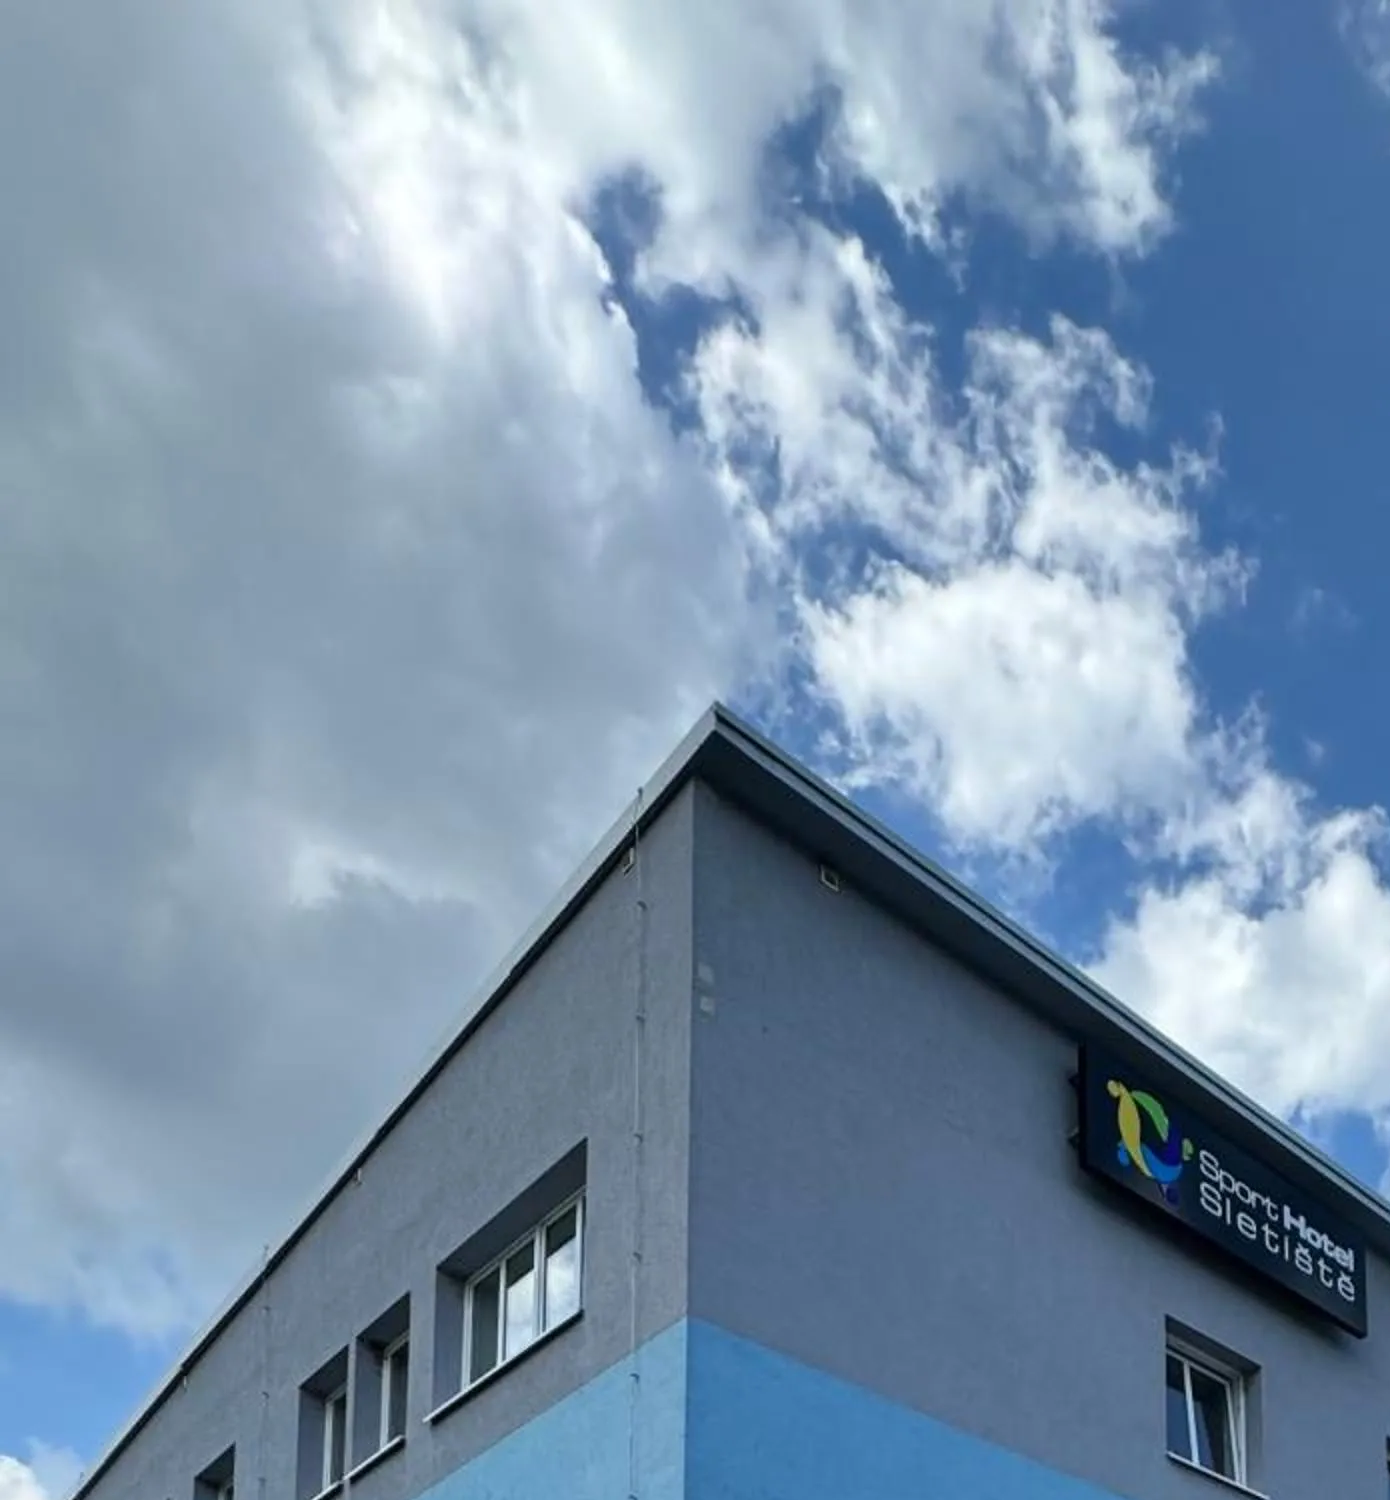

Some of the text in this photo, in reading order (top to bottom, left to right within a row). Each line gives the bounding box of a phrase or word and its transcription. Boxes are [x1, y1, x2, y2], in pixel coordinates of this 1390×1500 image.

[1199, 1149, 1355, 1273] Sport Hotel
[1200, 1182, 1356, 1302] Sletiště
